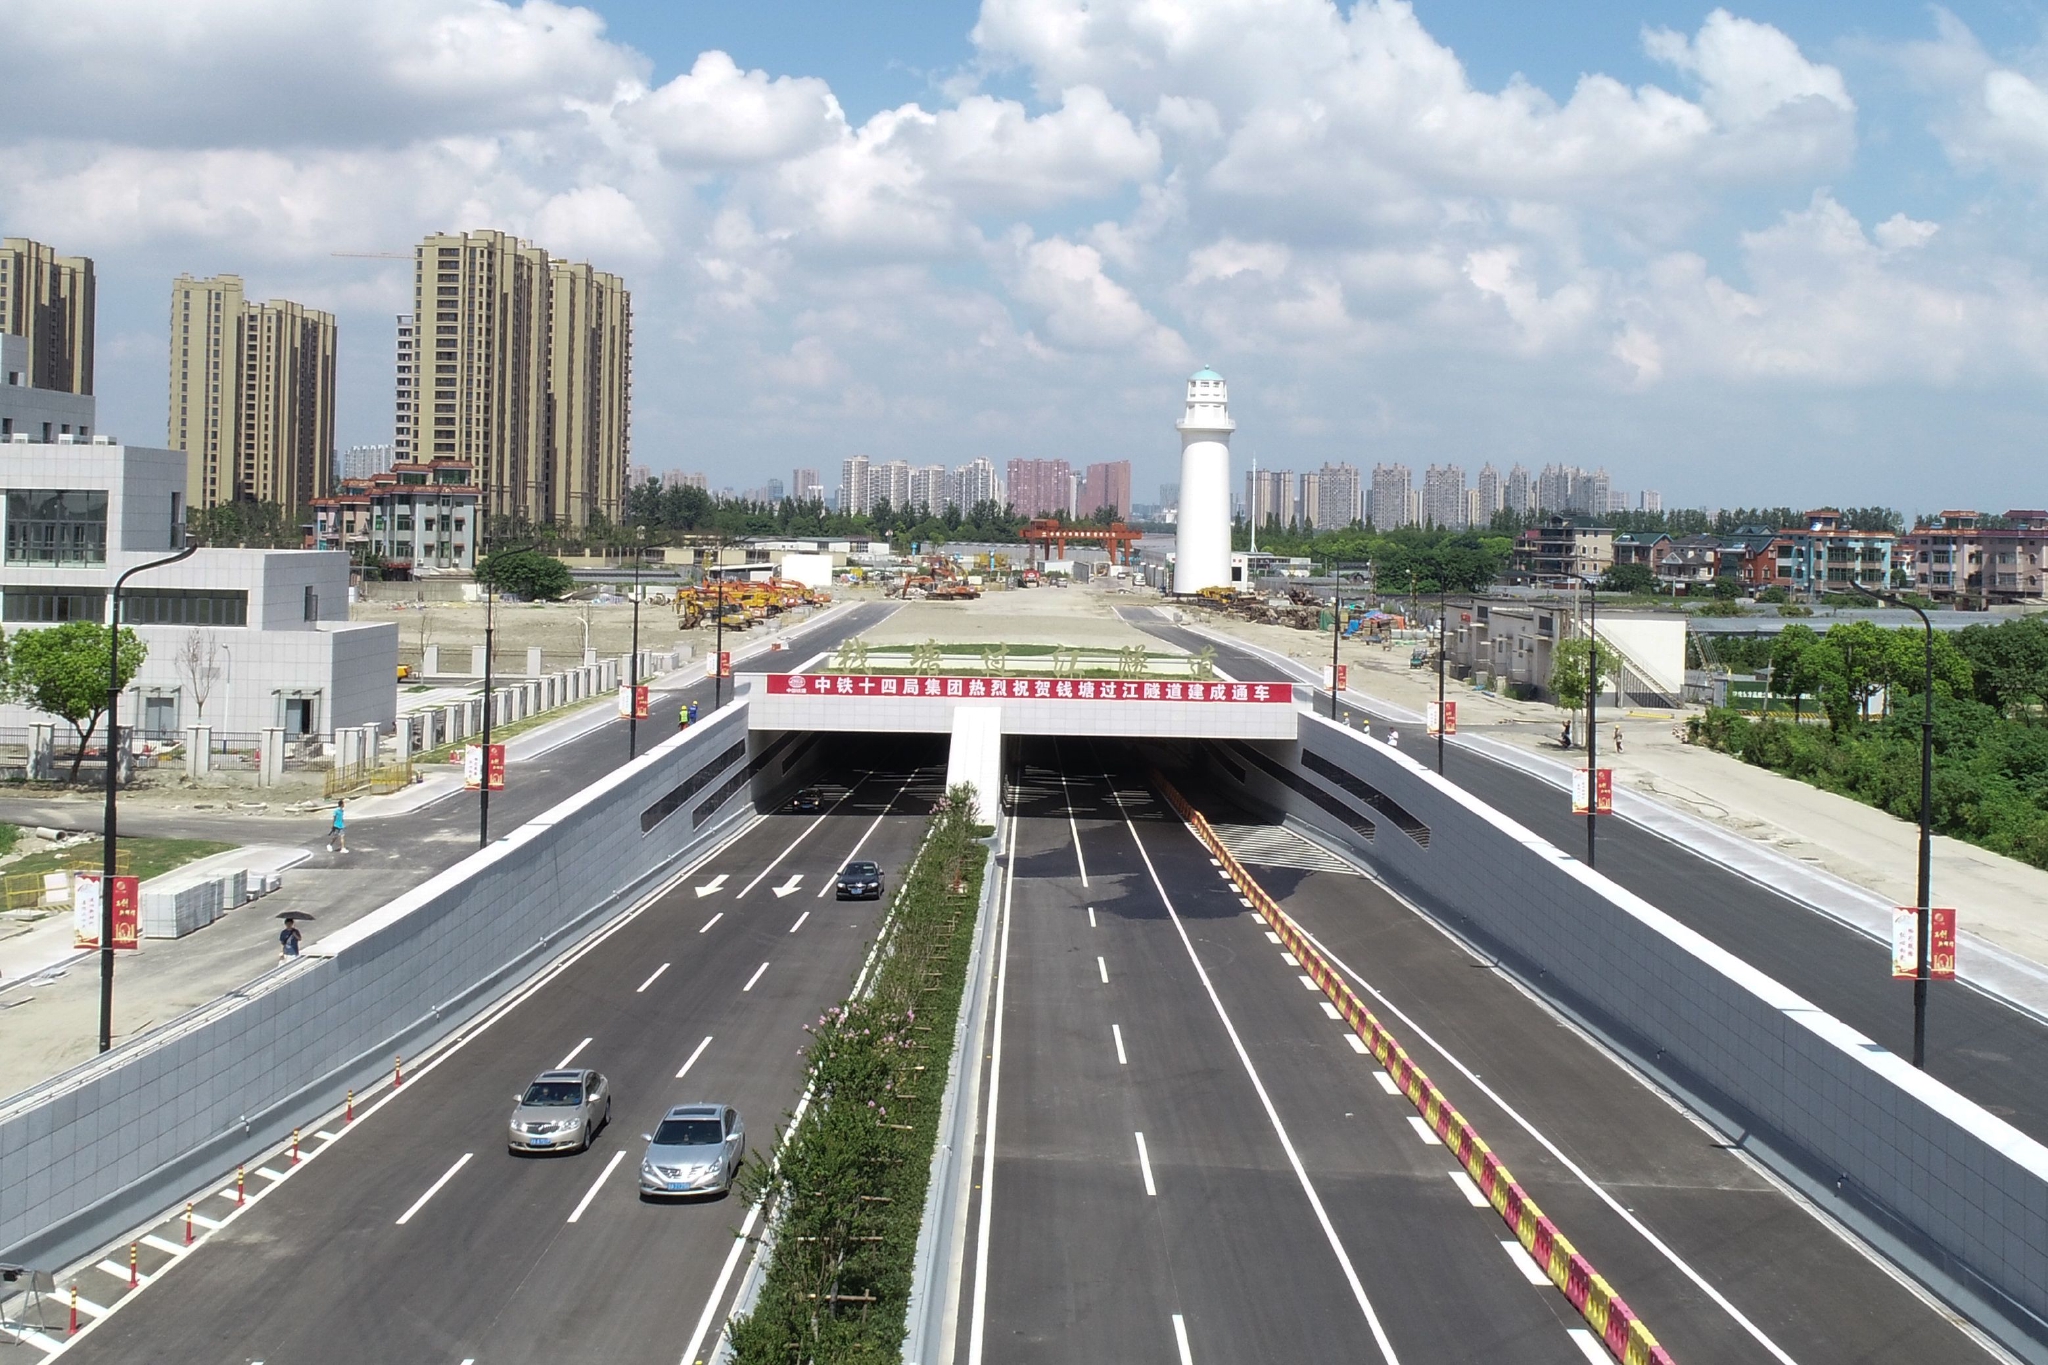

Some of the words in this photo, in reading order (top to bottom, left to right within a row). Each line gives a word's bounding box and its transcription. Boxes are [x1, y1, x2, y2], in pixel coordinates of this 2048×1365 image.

[834, 636, 1221, 680] 钱塘过江隧道
[814, 676, 1271, 701] 中铁十四局集团热烈祝贺钱塘过江隧道建成通车
